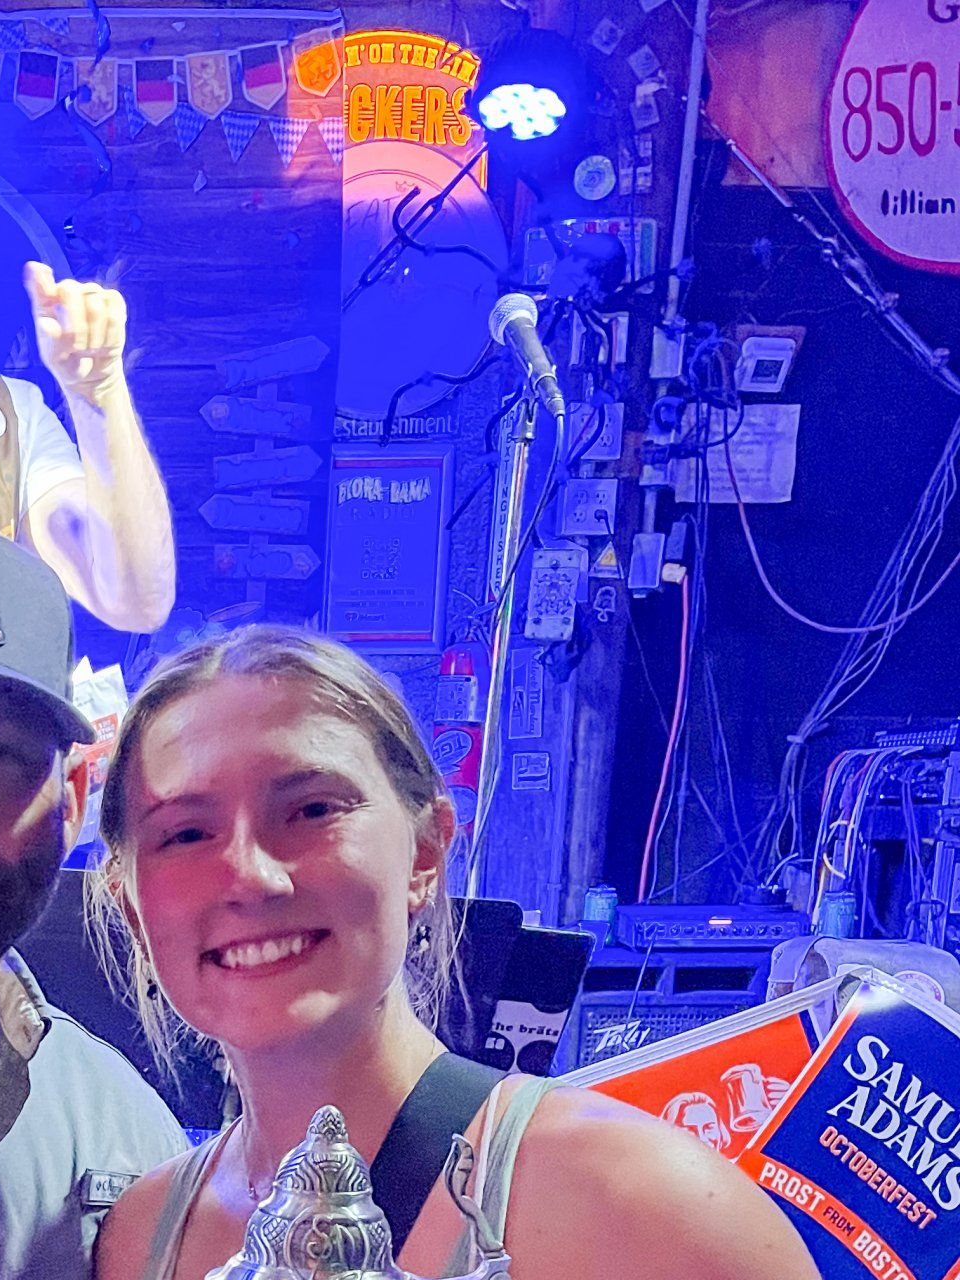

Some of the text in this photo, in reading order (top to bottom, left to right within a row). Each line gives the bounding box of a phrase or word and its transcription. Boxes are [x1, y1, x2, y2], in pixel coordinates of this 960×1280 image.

[369, 43, 395, 63] ON
[400, 44, 438, 69] THE
[440, 51, 477, 85] LIN
[819, 1125, 938, 1230] OCTOBERFEST
[826, 1085, 960, 1211] ADAMS
[758, 1161, 826, 1213] PROST
[823, 1206, 855, 1237] FROM
